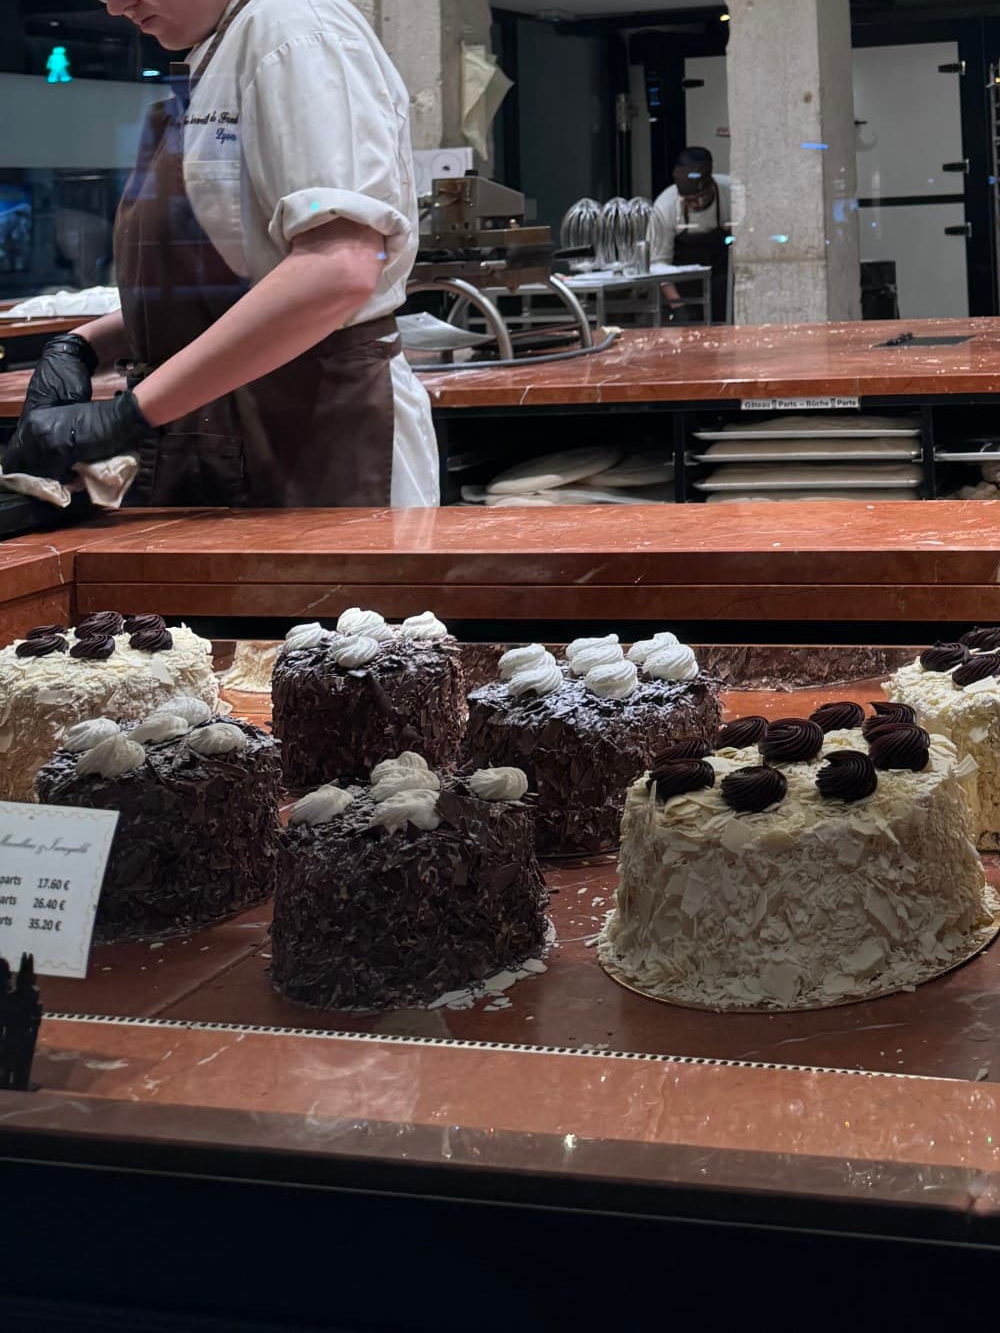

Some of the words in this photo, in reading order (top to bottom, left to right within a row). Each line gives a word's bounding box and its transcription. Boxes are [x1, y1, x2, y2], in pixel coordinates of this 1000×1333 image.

[37, 877, 62, 890] 17.60
[33, 897, 58, 910] 26.40
[28, 917, 53, 931] 35.20
